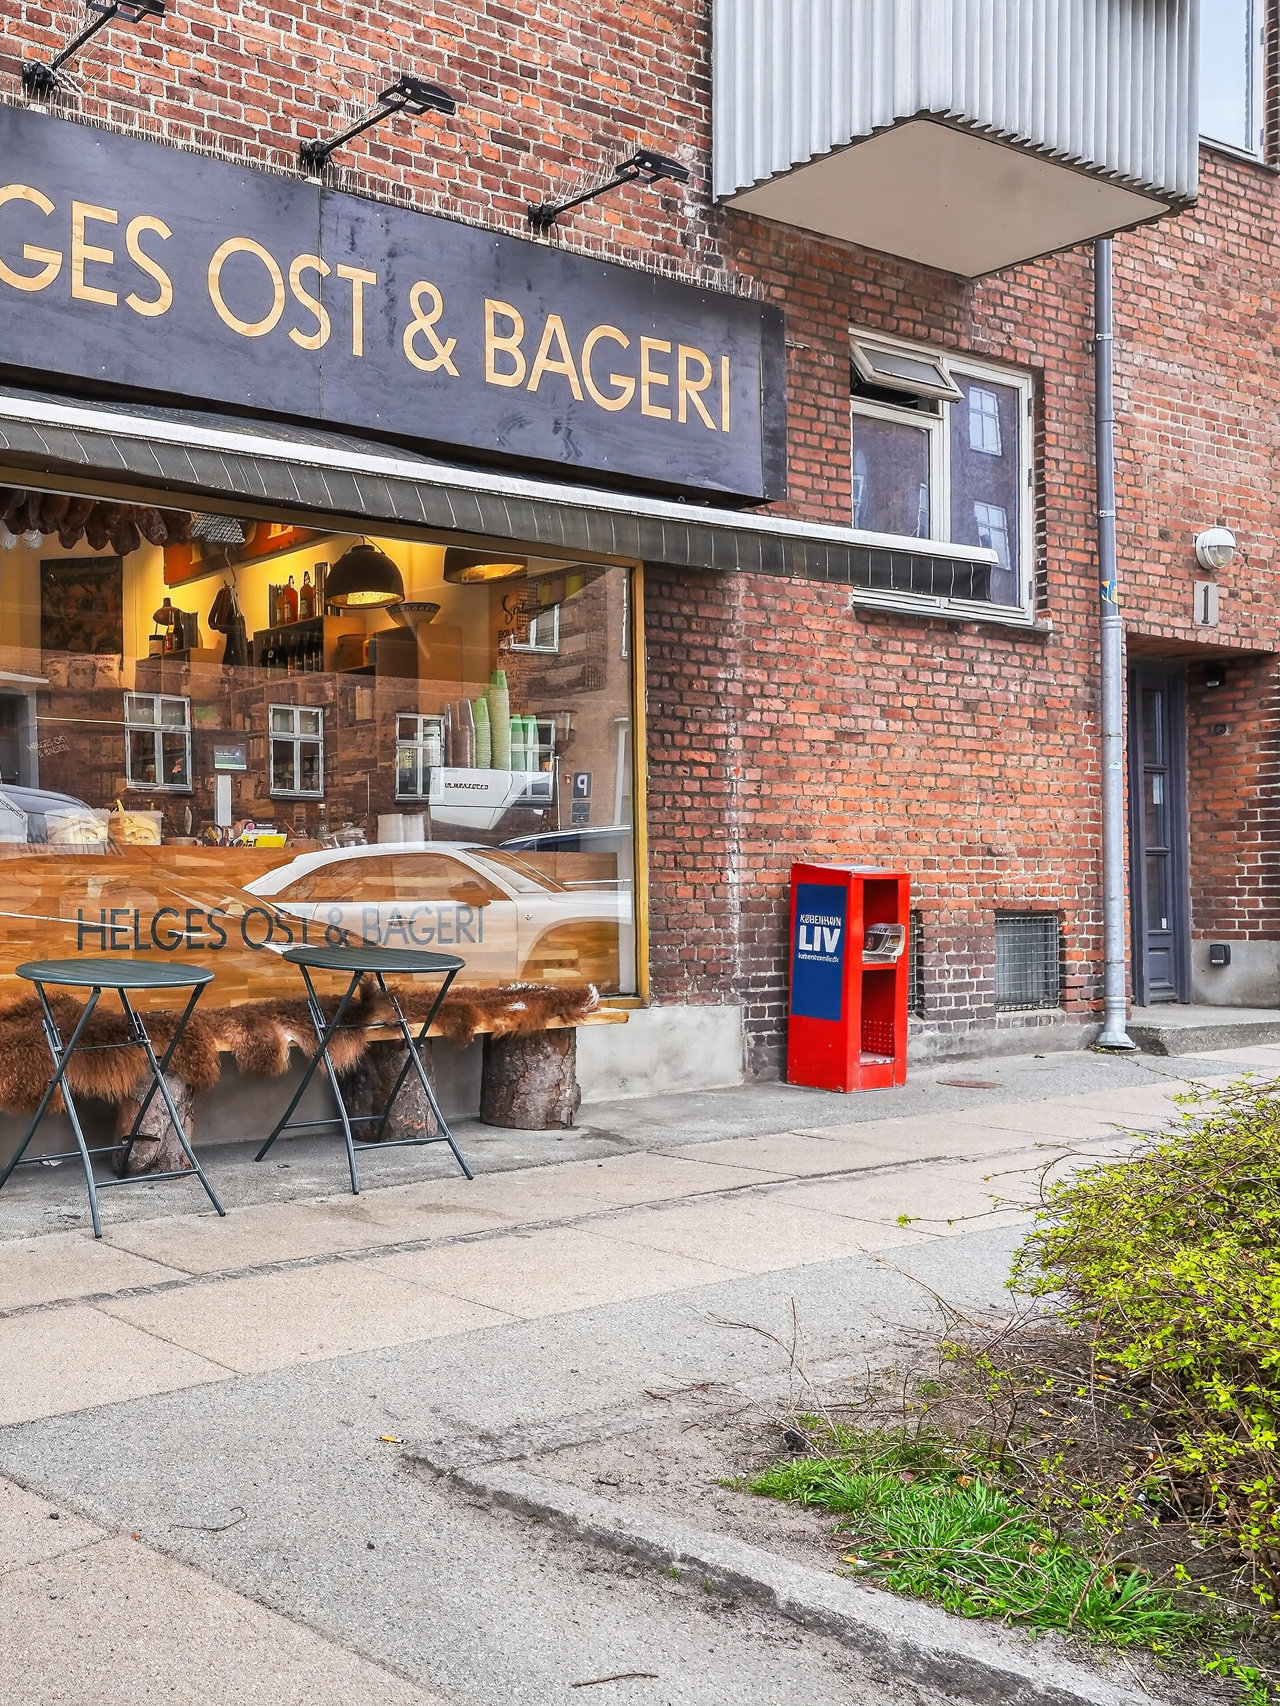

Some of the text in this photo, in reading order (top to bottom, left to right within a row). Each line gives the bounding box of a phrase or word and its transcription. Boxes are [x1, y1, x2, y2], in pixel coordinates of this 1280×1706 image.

[207, 236, 377, 357] OST
[403, 280, 460, 377] &
[484, 297, 731, 433] BAGERI
[1201, 585, 1210, 625] 1
[77, 905, 483, 951] HELGES OST & BAGERI
[799, 924, 841, 953] LIV
